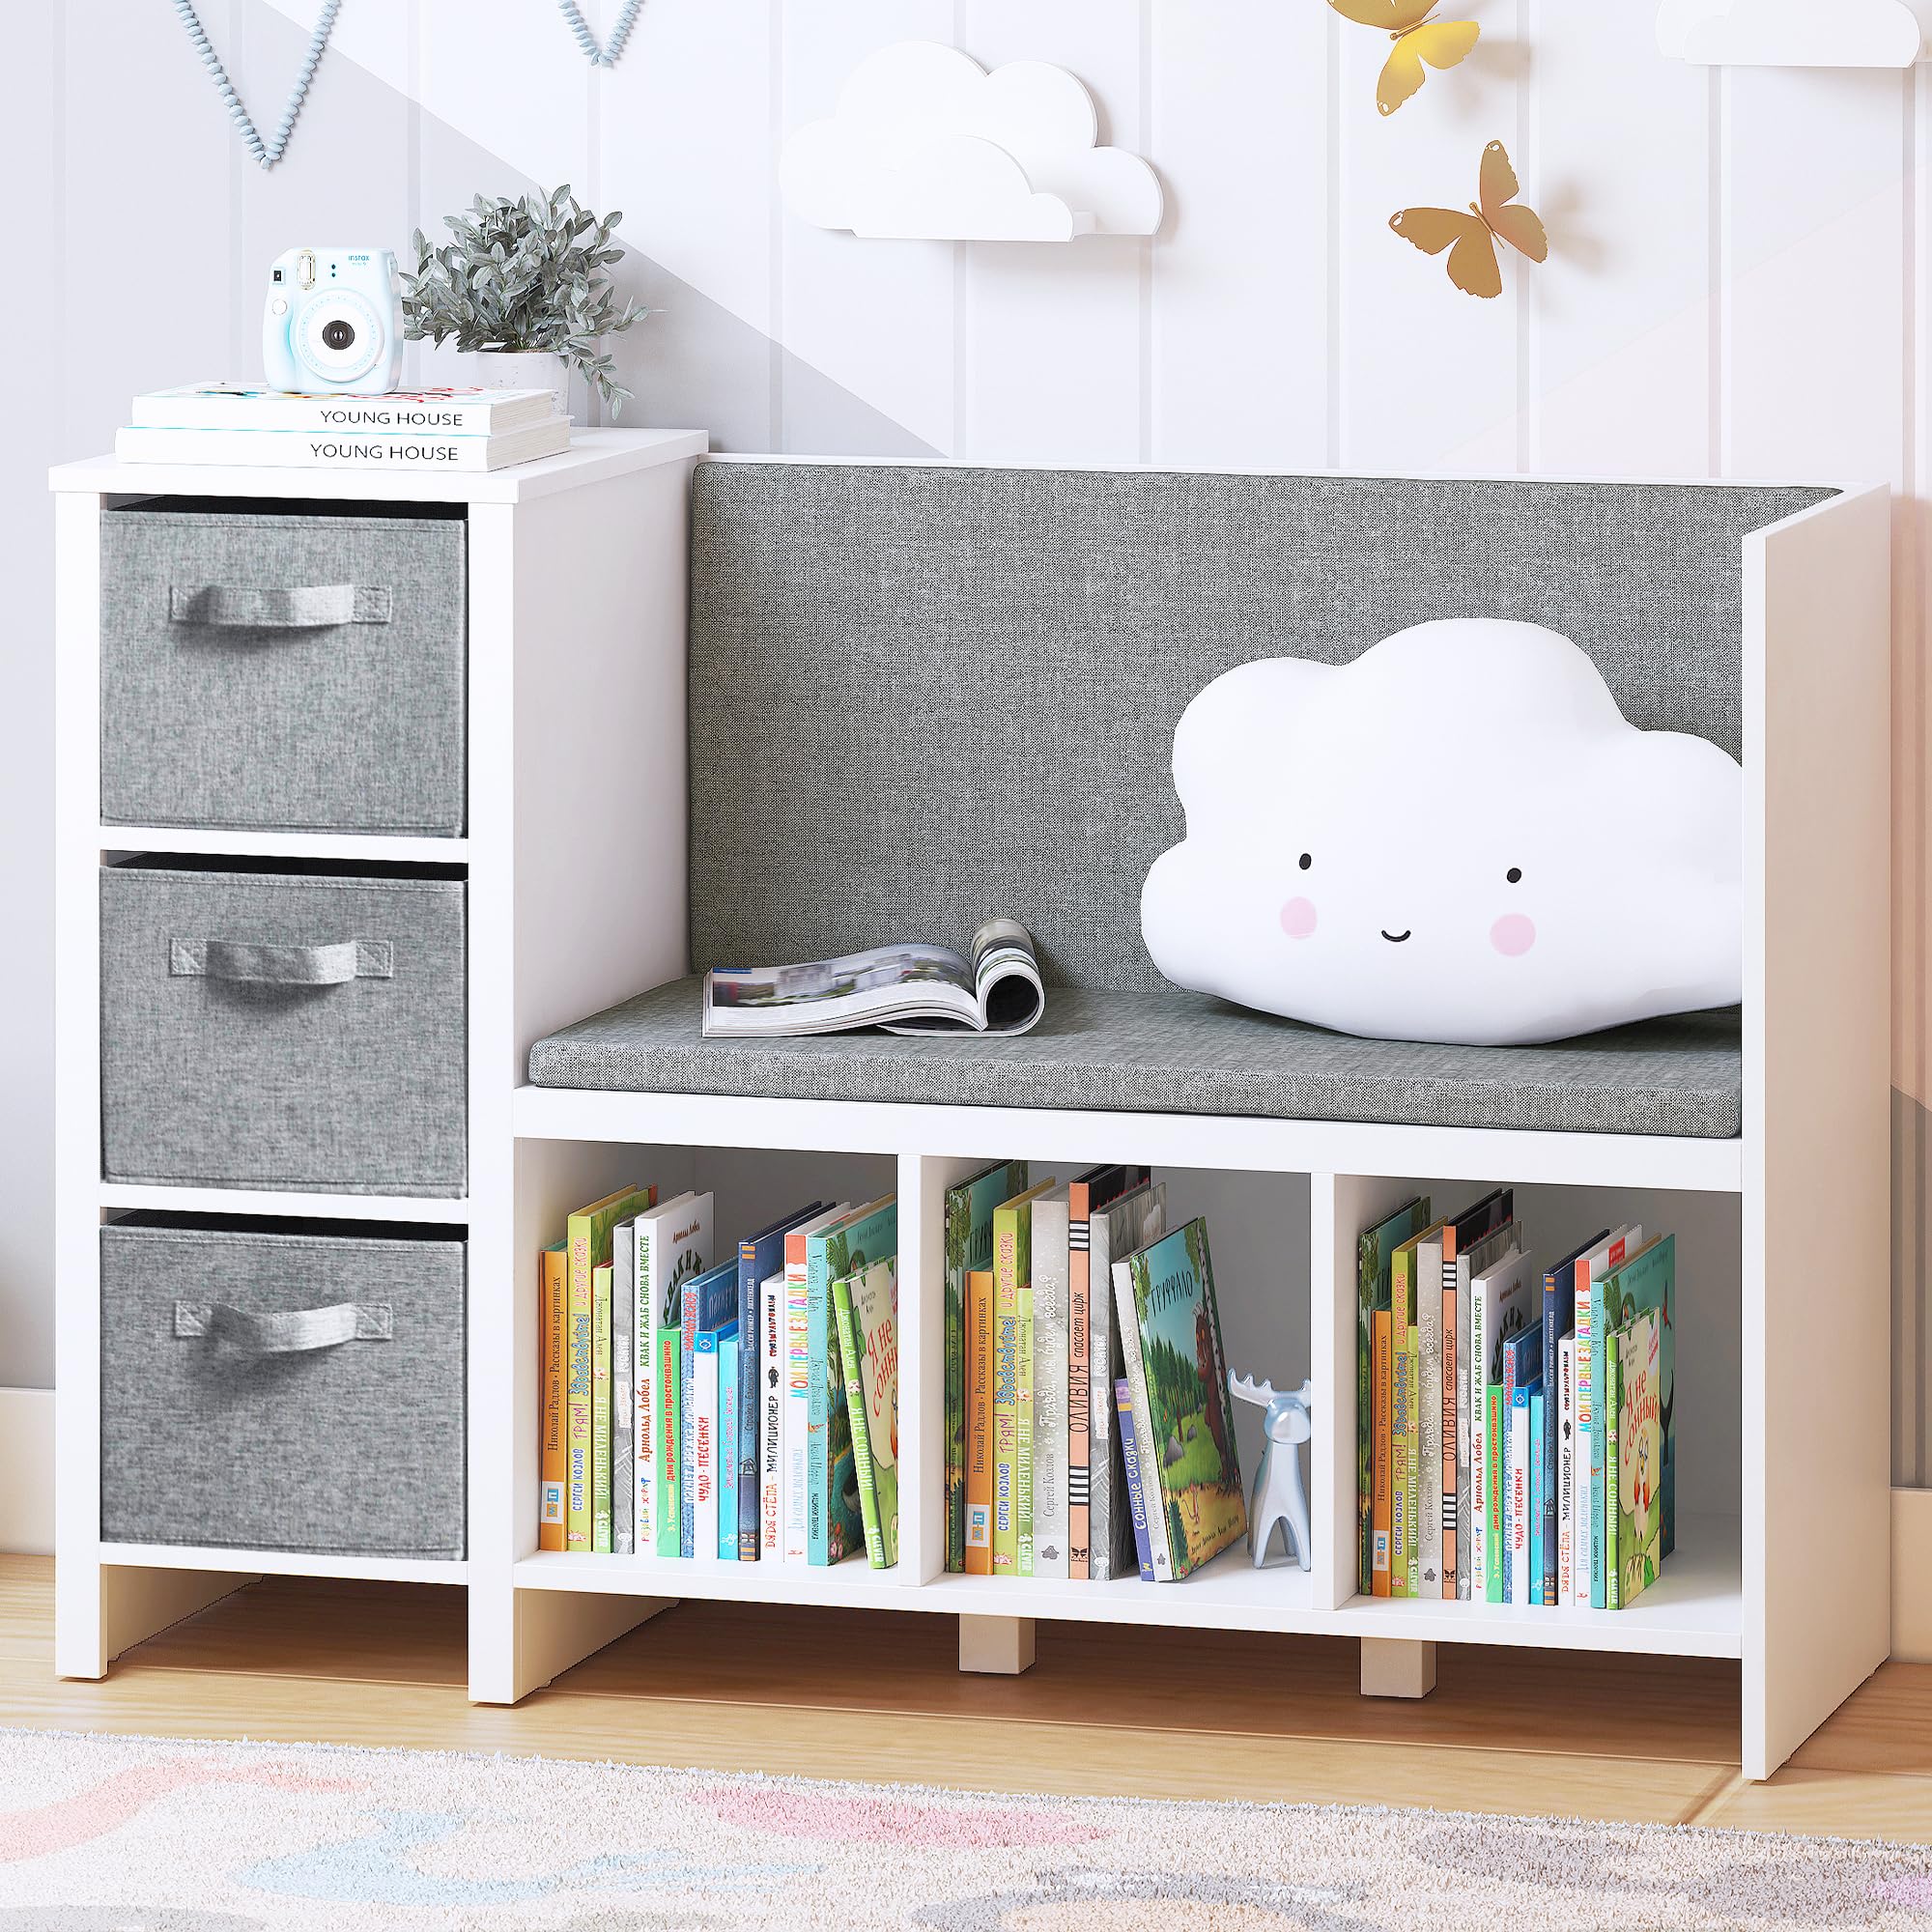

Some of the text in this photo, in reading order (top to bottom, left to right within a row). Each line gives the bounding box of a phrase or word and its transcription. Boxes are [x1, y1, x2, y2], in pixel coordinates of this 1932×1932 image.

[320, 411, 464, 427] YOUNG HOUSE
[310, 443, 459, 461] YOUNG HOUSE
[639, 1235, 650, 1273] ВМЕСТЕ
[551, 1276, 564, 1325] картинках
[639, 1274, 650, 1306] СНОВА
[787, 1273, 808, 1324] ЗАГАДКИ
[1036, 1274, 1059, 1319] всегда?
[639, 1306, 650, 1330] ЖАБ
[977, 1296, 990, 1346] картинках
[1474, 1295, 1483, 1331] ВМЕСТЕ
[1576, 1301, 1592, 1354] ЗАГАДКИ
[549, 1333, 561, 1374] Рассказы
[639, 1330, 650, 1340] И
[787, 1325, 809, 1369] ПЕРВЫЕ
[1037, 1323, 1065, 1355] будем
[1474, 1332, 1483, 1363] СНОВА
[568, 1314, 590, 1397] Здравствуйте!
[639, 1341, 650, 1368] КВАК
[994, 1315, 1017, 1406] Здравствуйте!
[1068, 1292, 1089, 1434] ОЛИВИЯ спасает цирк
[1379, 1334, 1390, 1380] картинках
[663, 1340, 675, 1410] простоквашино
[788, 1371, 809, 1399] МОИ
[975, 1354, 987, 1395] Рассказы
[1474, 1364, 1483, 1386] ЖАБ
[1576, 1356, 1592, 1402] ПЕРВЫЕ
[548, 1379, 561, 1410] Радлов
[635, 1378, 650, 1412] Лобел
[1378, 1388, 1387, 1427] Рассказы
[1392, 1351, 1407, 1437] Здравствуйте!
[1442, 1328, 1456, 1462] ОЛИВИЯ спасает цирк
[1474, 1397, 1483, 1422] КВАК
[547, 1412, 559, 1452] Николай
[568, 1403, 588, 1440] ТРЯМ!
[595, 1406, 609, 1422] НЕ
[974, 1401, 987, 1433] Радлов
[1491, 1395, 1500, 1462] простоквашино
[1577, 1405, 1592, 1433] МОИ
[638, 1414, 652, 1463] Арнольд
[664, 1417, 676, 1463] рождения
[766, 1396, 780, 1473] МИЛИЦИОНЕР
[851, 1406, 874, 1492] Я НЕ СОННЫЙ!
[994, 1413, 1015, 1454] ТРЯМ!
[1018, 1429, 1032, 1445] НЕ
[1378, 1433, 1387, 1463] Радлов
[1472, 1433, 1483, 1464] Лобел
[571, 1448, 583, 1480] КОЗЛОВ
[665, 1463, 676, 1482] дни
[696, 1416, 711, 1502] ЧУДО ПЕСЕНКИ
[972, 1435, 985, 1474] Николай
[1392, 1444, 1406, 1482] ТРЯМ!
[1407, 1457, 1417, 1473] НЕ
[997, 1463, 1010, 1497] КОЗЛОВ
[1041, 1453, 1059, 1517] Сергей Козлов
[1378, 1464, 1387, 1502] Николай
[1473, 1467, 1484, 1513] Арнольд
[1491, 1469, 1500, 1513] рождения
[1562, 1446, 1572, 1521] МИЛИЦИОНЕР
[1607, 1455, 1618, 1536] Я НЕ СОННЫЙ!
[762, 1483, 778, 1518] СТЁПА
[1394, 1491, 1403, 1523] КОЗЛОВ
[1515, 1468, 1524, 1550] ЧУДО ПЕСЕНКИ
[764, 1520, 778, 1548] ДЯДЯ
[1424, 1512, 1435, 1542] Сергей
[1492, 1514, 1500, 1530] дни
[1559, 1531, 1570, 1563] СТЁПА
[1561, 1565, 1570, 1593] ДЯДЯ
